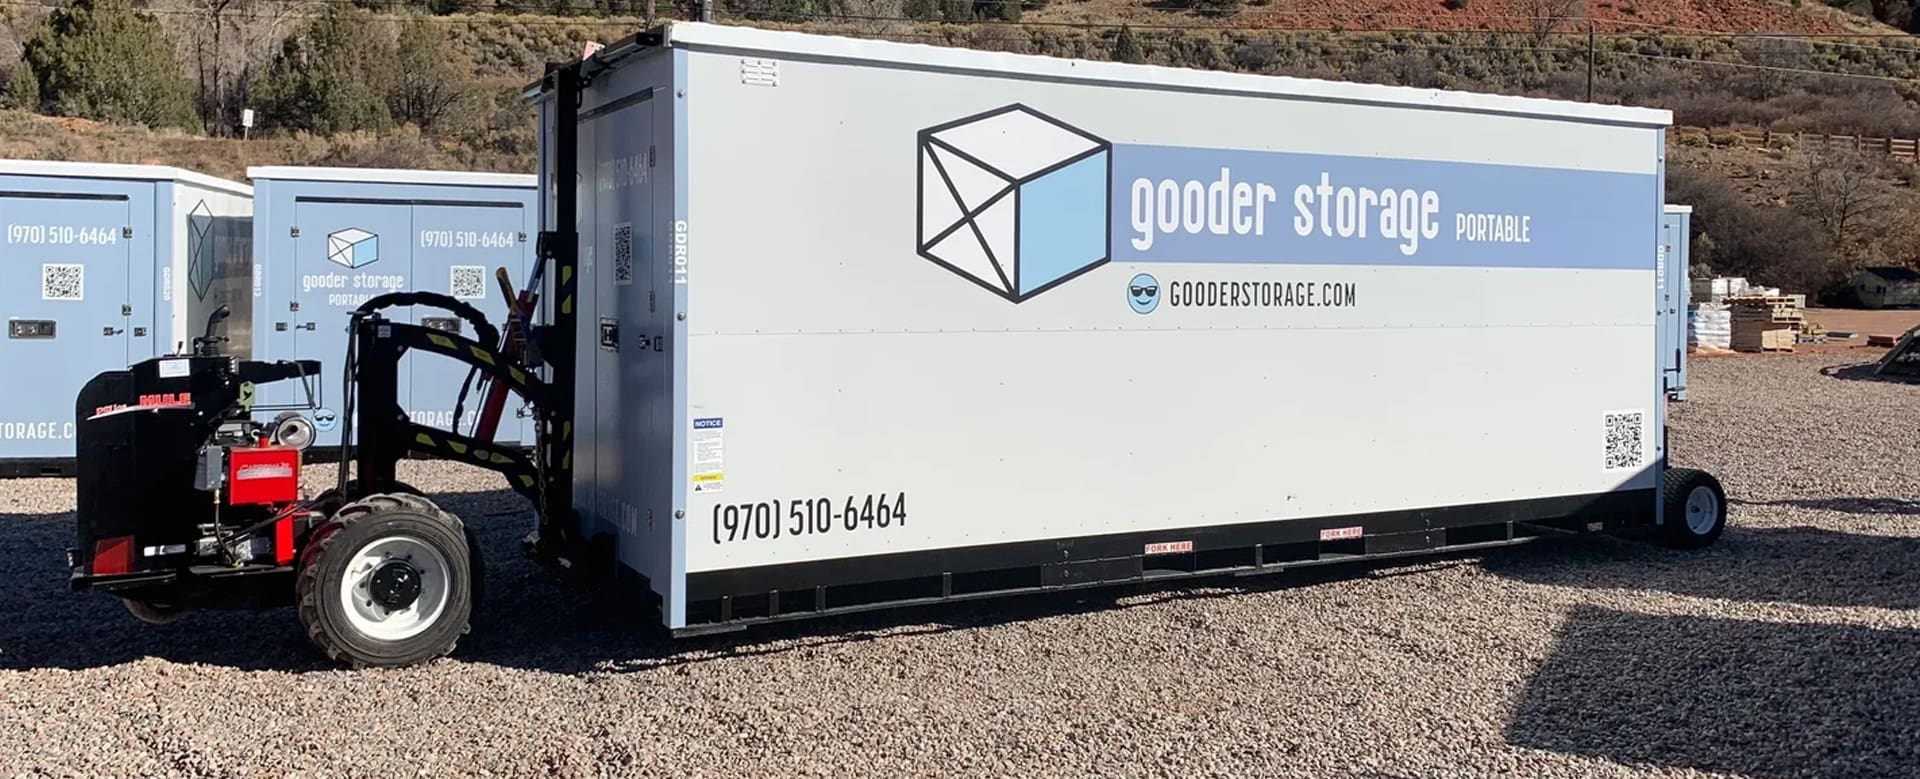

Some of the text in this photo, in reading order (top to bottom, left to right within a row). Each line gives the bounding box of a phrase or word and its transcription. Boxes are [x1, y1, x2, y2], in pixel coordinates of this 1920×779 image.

[1131, 167, 1531, 256] gooder storage PORTABLE
[8, 224, 117, 245] (970) 510-6464
[420, 230, 514, 248] (970) 510-6464
[675, 220, 687, 284] GDR011
[303, 272, 404, 292] gooder storage
[1170, 281, 1357, 308] GOODERSTORAGE.COM
[139, 392, 191, 408] MULE
[0, 422, 77, 439] TORAGE.C
[695, 420, 721, 428] NOTICE
[713, 492, 907, 545] (970) 510-6464
[1320, 527, 1362, 539] FORK HERE
[1145, 542, 1191, 552] FORK HERE
